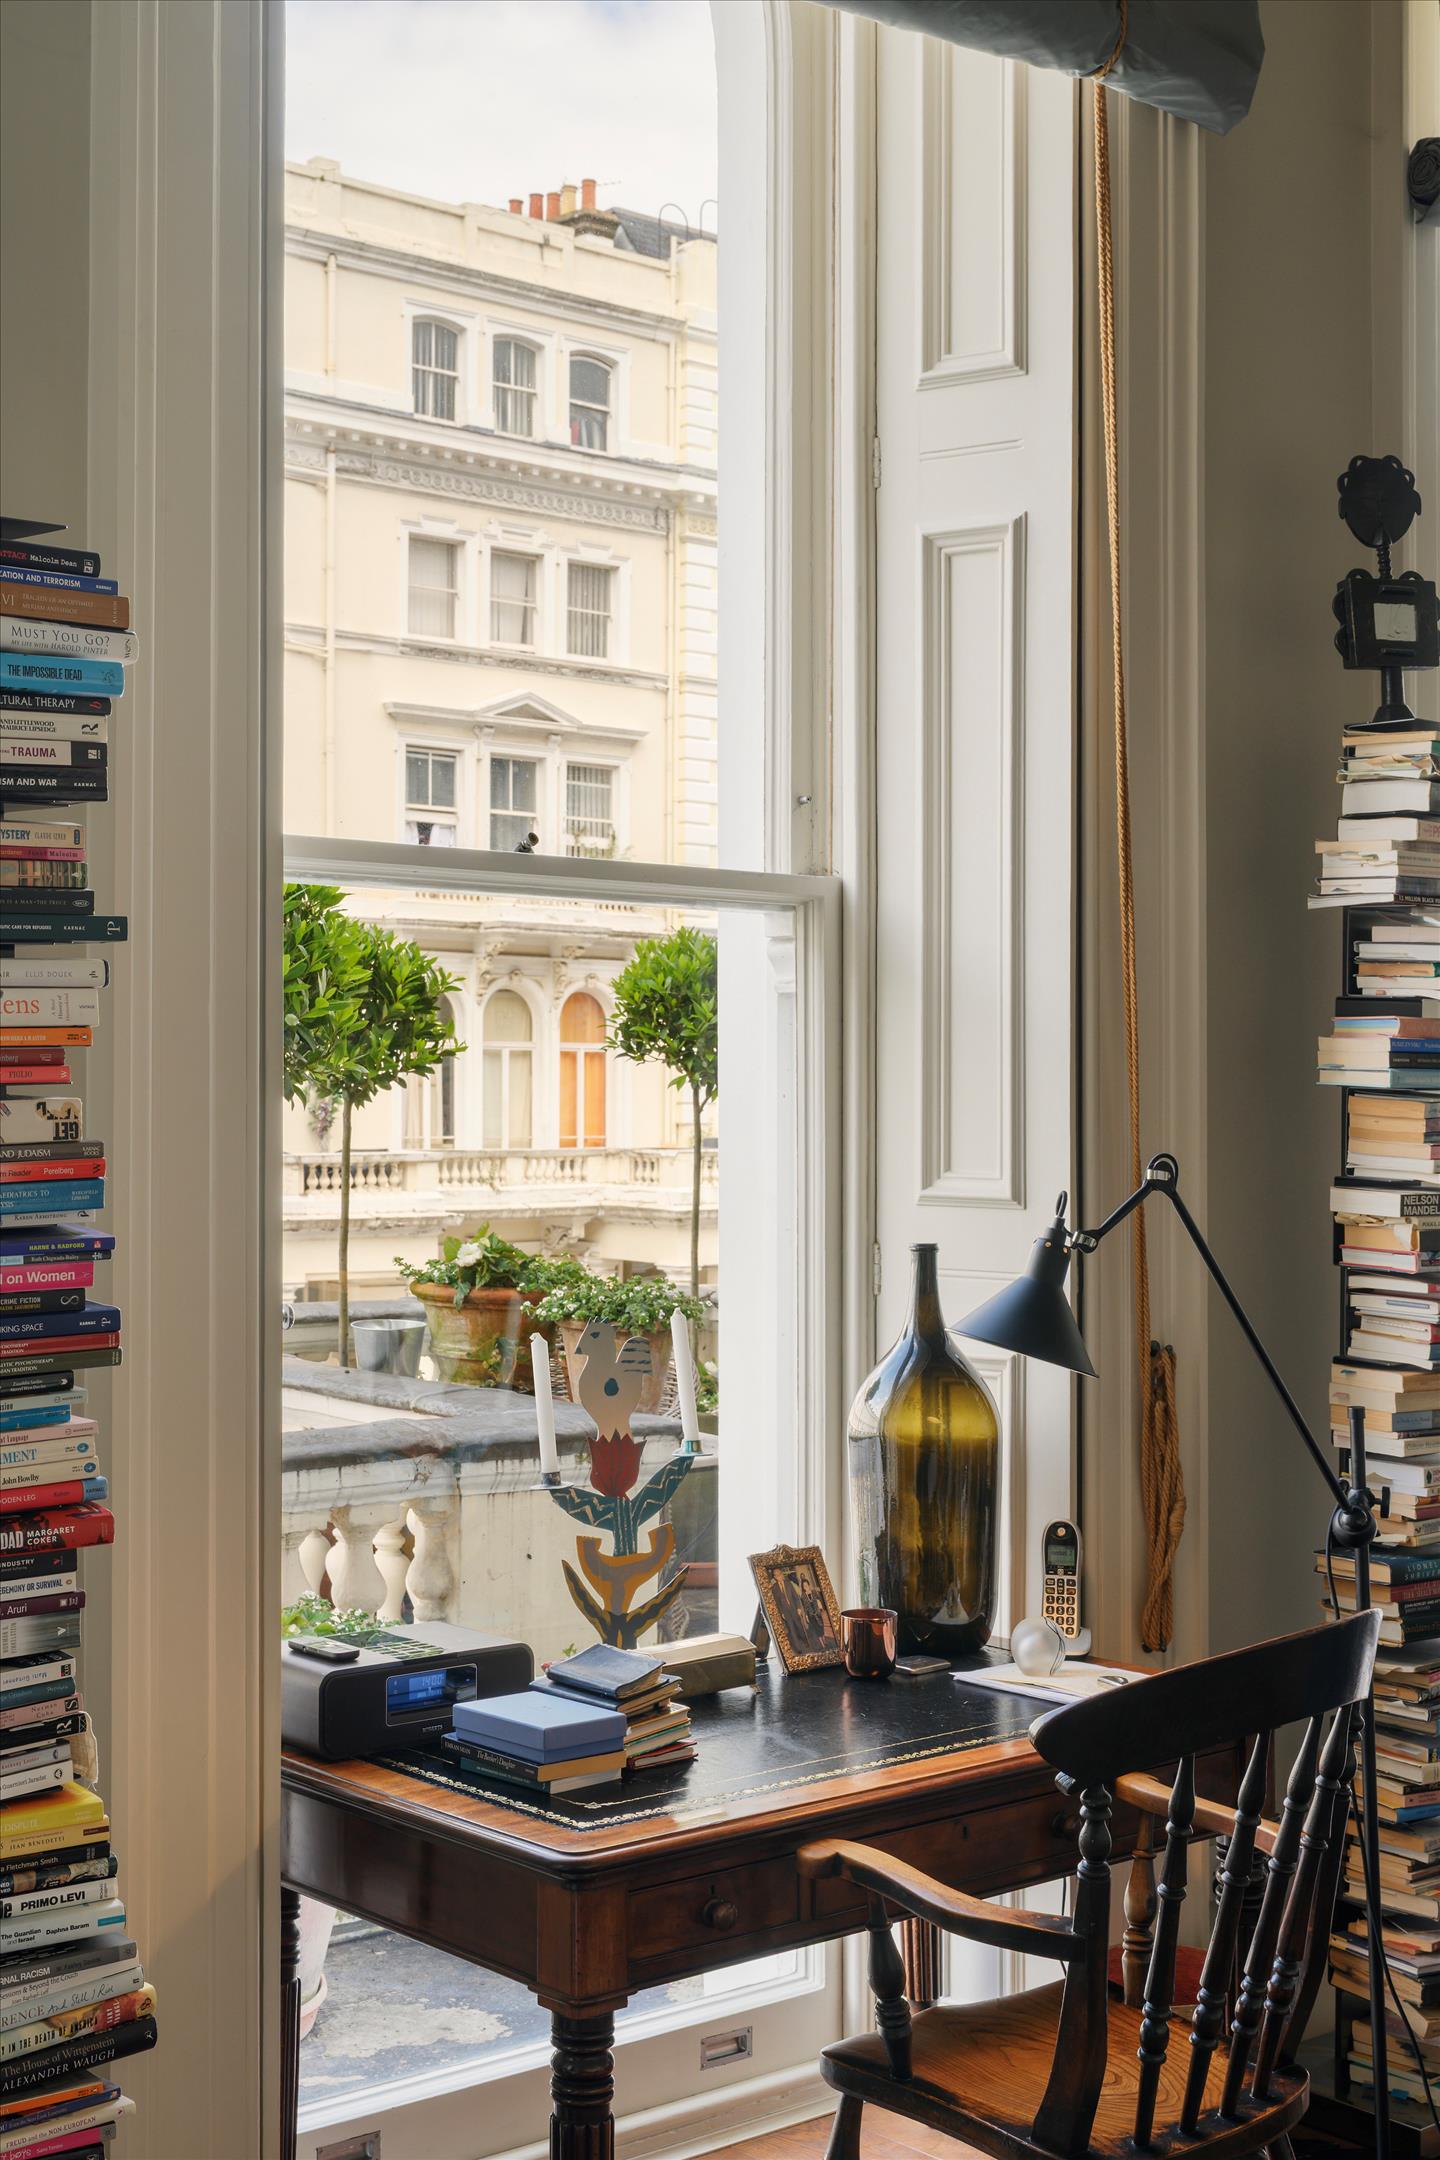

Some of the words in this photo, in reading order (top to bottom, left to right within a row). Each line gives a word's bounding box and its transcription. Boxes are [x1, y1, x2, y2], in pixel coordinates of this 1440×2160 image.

[30, 554, 60, 565] Malcolm
[61, 557, 78, 568] Dean
[26, 573, 42, 583] AND
[43, 575, 81, 588] TERRORISM
[12, 625, 47, 641] MUST
[53, 630, 79, 643] YOU
[85, 634, 110, 648] GO?
[51, 642, 81, 652] HAROLD
[84, 646, 109, 655] PINTER
[8, 664, 20, 676] THE
[22, 665, 62, 679] IMPOSSIBLE
[65, 669, 83, 681] DEAD
[35, 696, 76, 709] THERAPY
[13, 720, 55, 728] LITTLEWOOD
[11, 746, 57, 758] TRAUMA
[17, 778, 36, 786] AND
[38, 778, 57, 787] WAR
[25, 970, 44, 978] ELLIS
[17, 1149, 51, 1159] JUDAISM
[8, 1167, 32, 1177] Reader
[41, 1190, 50, 1198] TO
[1403, 1195, 1439, 1205] NELSON
[1403, 1206, 1440, 1216] MANDEL
[7, 1273, 23, 1285] on
[27, 1271, 76, 1284] Women
[0, 1297, 18, 1305] CRIME
[20, 1296, 41, 1304] FICTION
[22, 1322, 44, 1333] SPACE
[2, 1477, 17, 1486] John
[18, 1474, 39, 1484] Bowlby
[23, 1494, 36, 1502] LEG
[1, 1530, 24, 1550] DAD
[27, 1526, 76, 1538] MARGARET
[27, 1536, 57, 1546] COKER
[1407, 1561, 1439, 1572] LIONEL
[36, 1578, 63, 1590] SURVIVAL
[7, 1603, 28, 1615] Aruri
[28, 1836, 66, 1848] BENEDETTI
[6, 1859, 39, 1871] Fletchman
[40, 1855, 59, 1866] Smith
[21, 1897, 59, 1911] PRIMO
[60, 1890, 86, 1904] LEVI
[14, 1928, 42, 1938] Guardian
[46, 1927, 69, 1936] Daphna
[70, 1923, 90, 1931] Baram
[18, 1935, 36, 1944] Israel
[20, 1967, 51, 1981] RACISM
[28, 1981, 50, 1992] Beyond
[51, 1976, 60, 1985] the
[2, 2004, 45, 2027] RENCE
[46, 2003, 68, 2016] And
[71, 1992, 89, 2006] Still
[9, 2043, 16, 2053] IN
[20, 2037, 32, 2050] THE
[35, 2030, 56, 2045] DEATH
[59, 2026, 67, 2037] OF
[70, 2016, 98, 2034] AMERICA
[2, 2065, 21, 2078] The
[22, 2058, 50, 2071] House
[52, 2053, 61, 2063] of
[62, 2038, 115, 2058] Wittgenstein
[2, 2065, 69, 2092] ALEXANDER
[73, 2050, 115, 2068] WAUGH
[6, 2137, 27, 2149] FREUD
[28, 2134, 38, 2142] and
[38, 2131, 47, 2139] the
